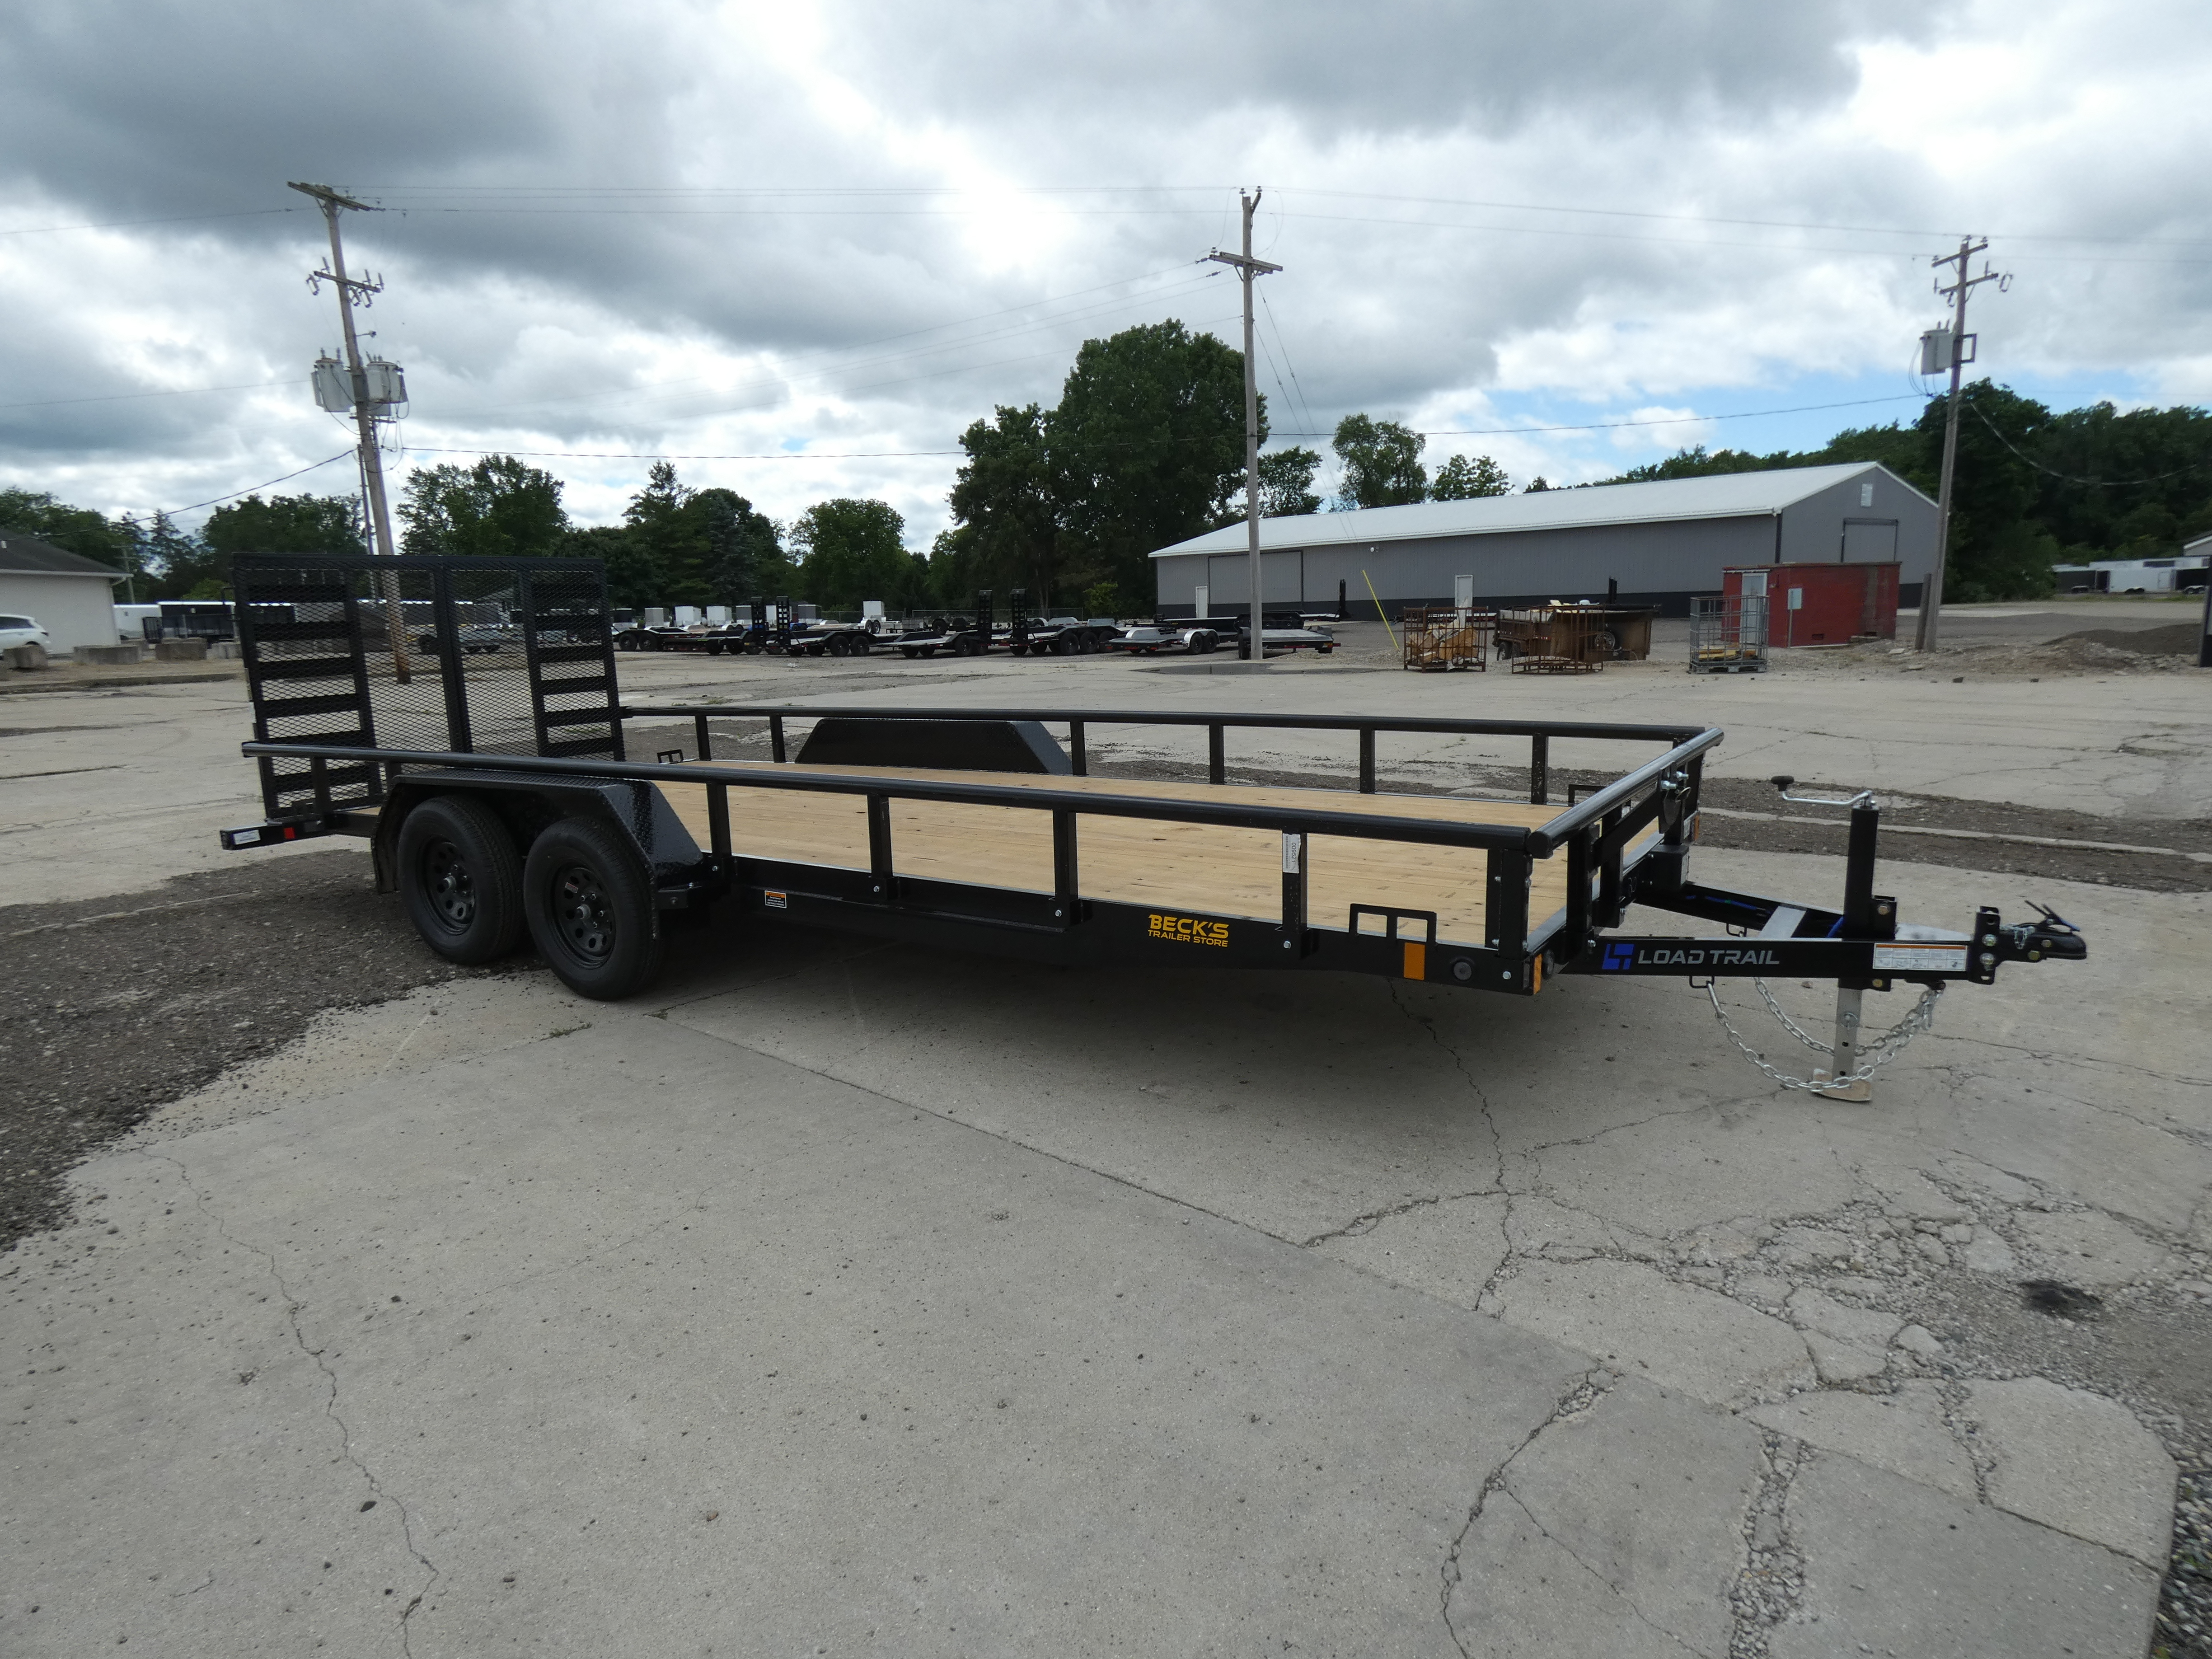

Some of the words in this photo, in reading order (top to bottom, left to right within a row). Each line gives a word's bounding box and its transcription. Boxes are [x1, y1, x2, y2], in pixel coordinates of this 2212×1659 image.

[1148, 914, 1229, 939] BECK'S
[1148, 929, 1191, 942] TRAILER
[1193, 936, 1229, 947] STORE
[1637, 950, 1705, 964] LOAD
[1709, 950, 1780, 965] TRAIL
